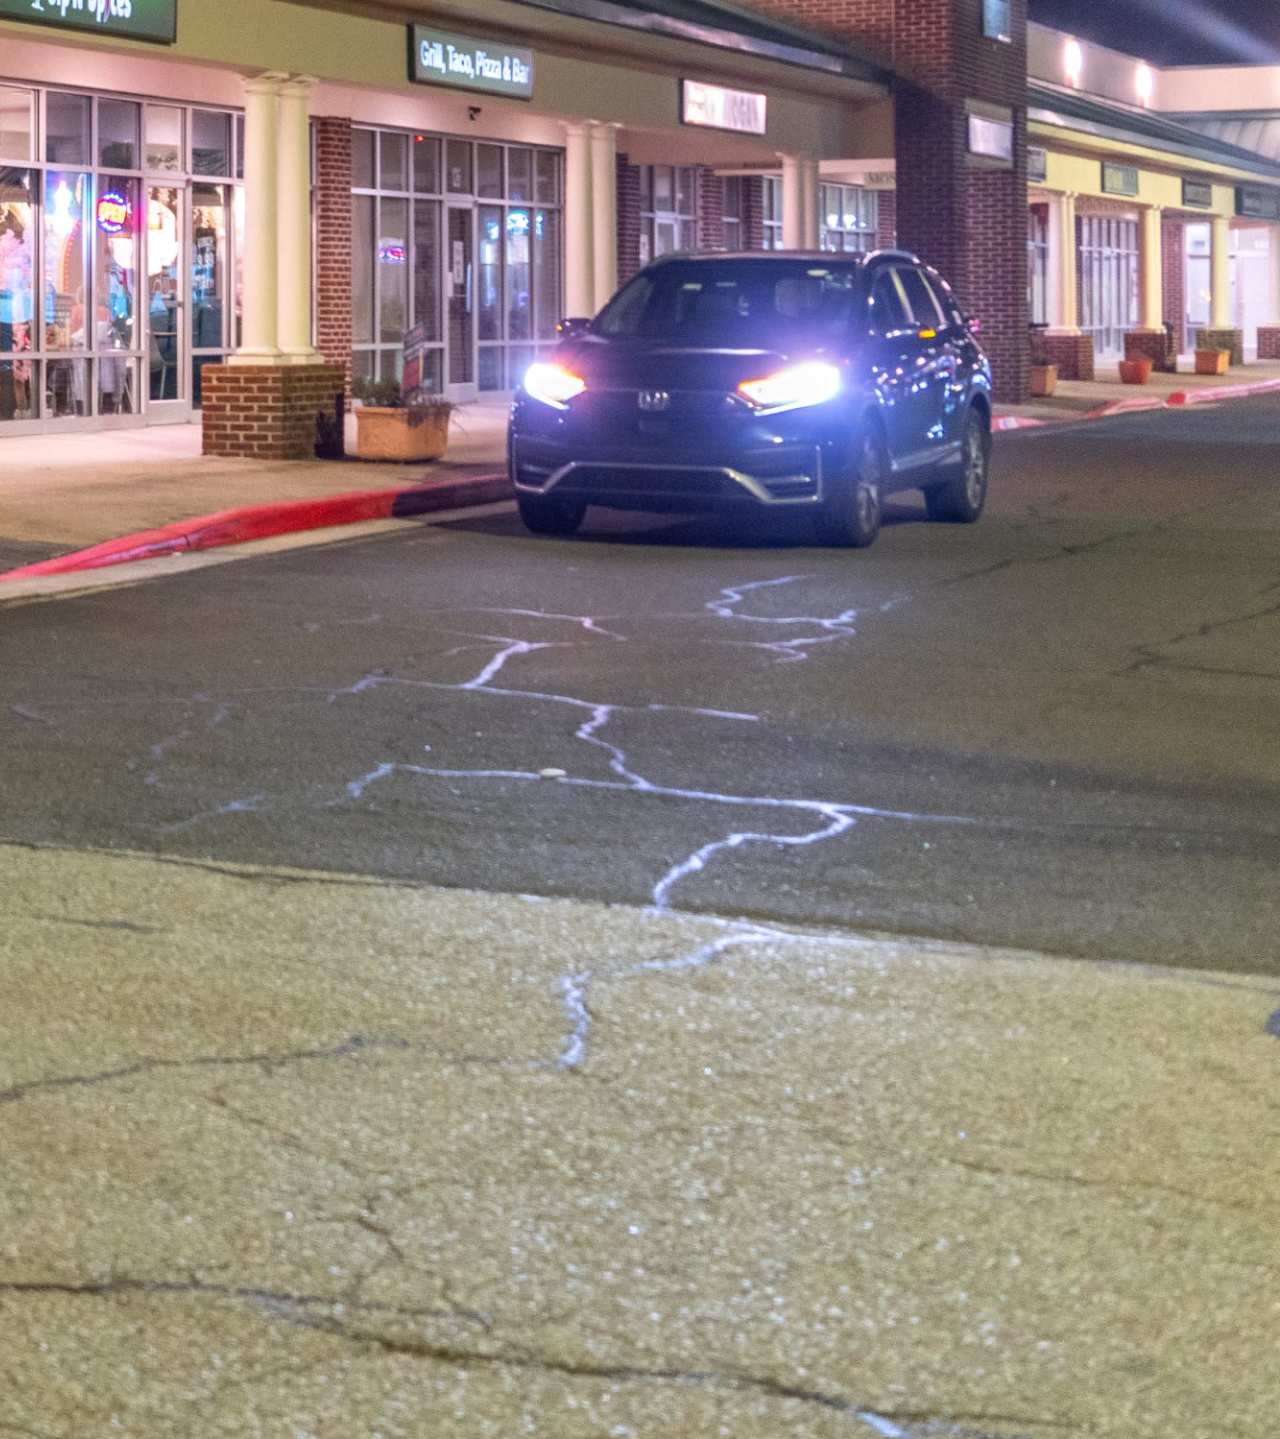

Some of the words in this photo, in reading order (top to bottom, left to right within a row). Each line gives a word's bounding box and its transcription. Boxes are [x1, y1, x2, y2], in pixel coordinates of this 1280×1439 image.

[420, 40, 446, 74] Grill,
[446, 44, 474, 79] Taco,
[475, 50, 502, 80] Pizza
[502, 56, 512, 81] &
[512, 58, 530, 83] Bar
